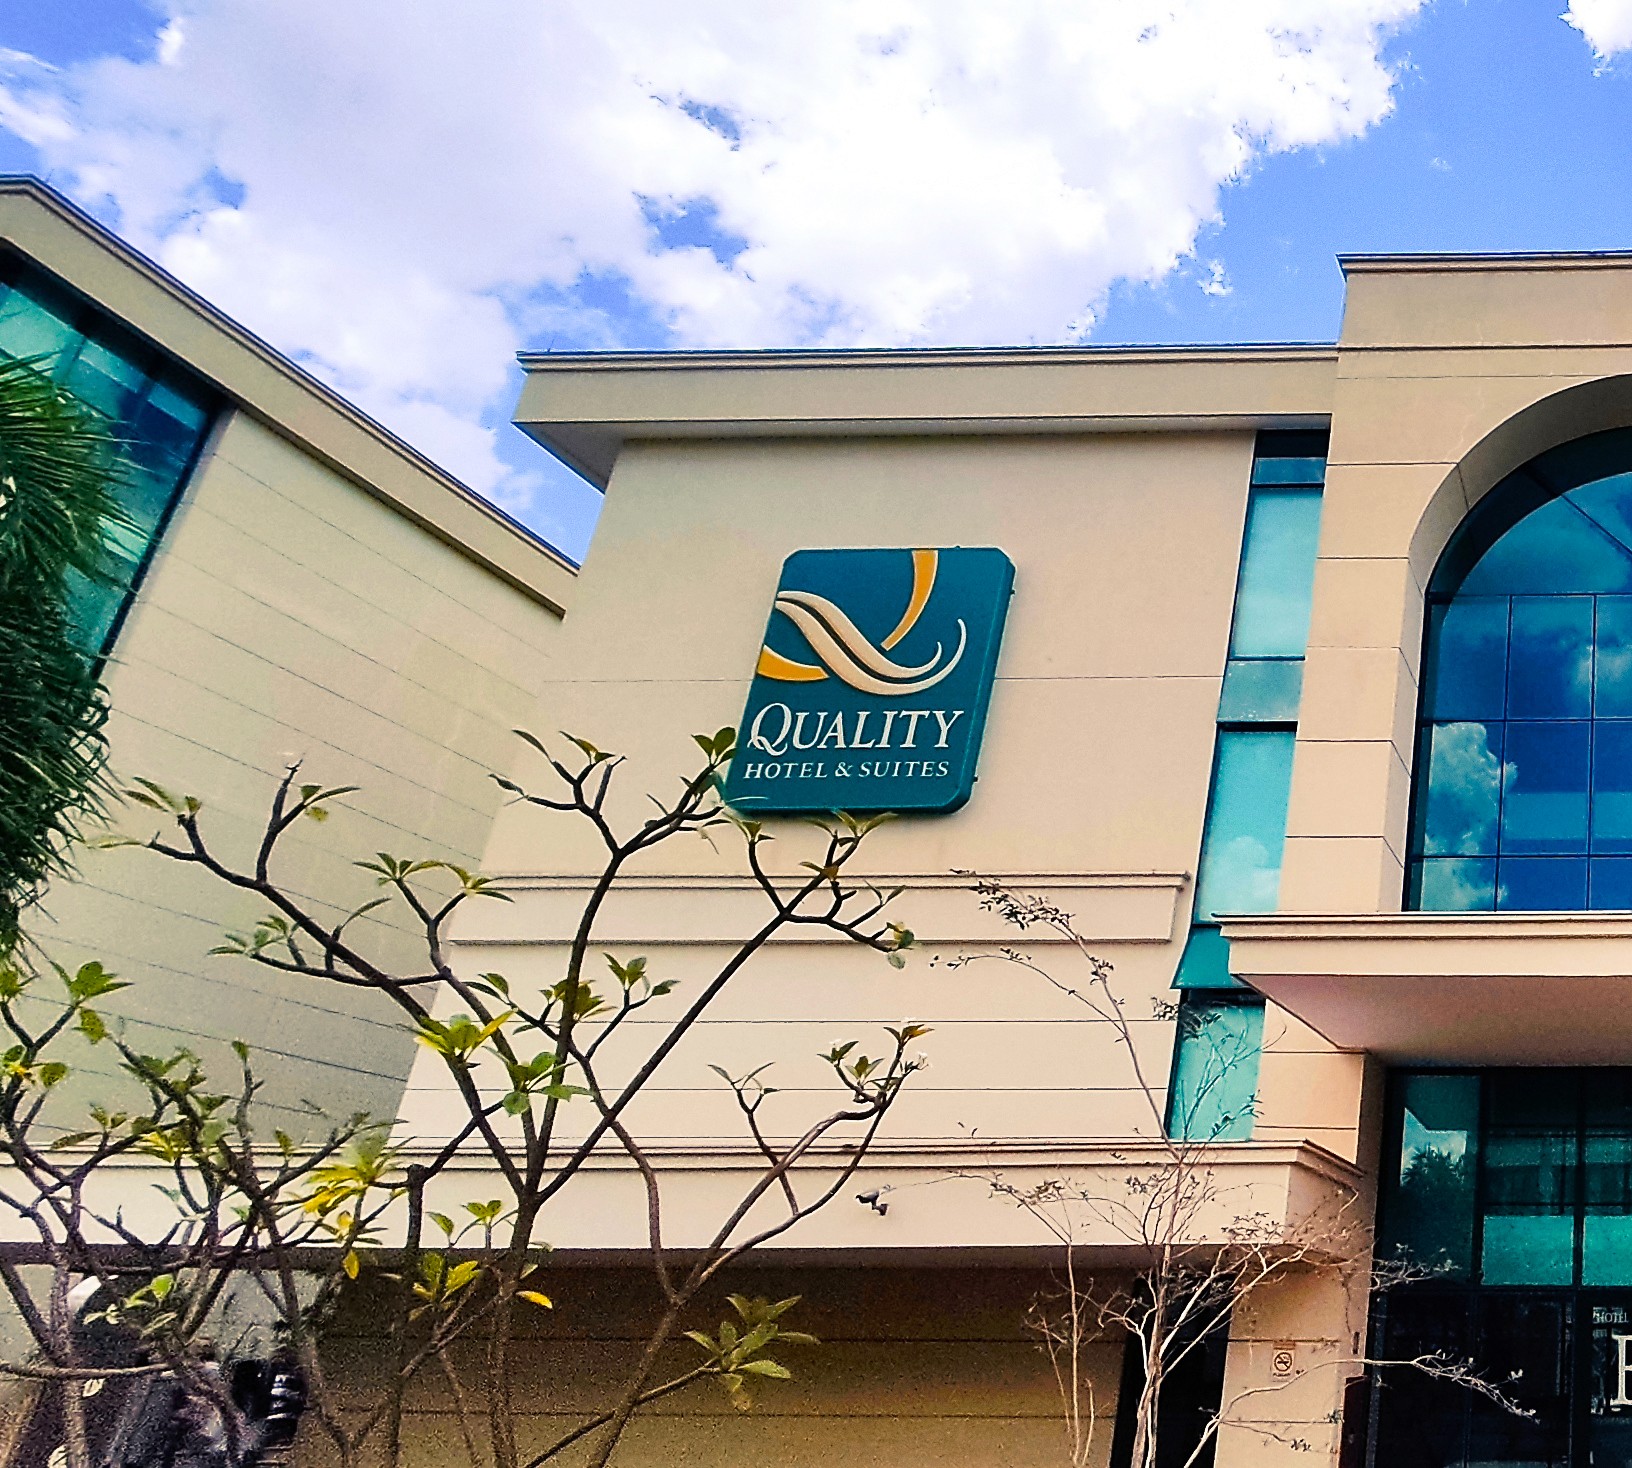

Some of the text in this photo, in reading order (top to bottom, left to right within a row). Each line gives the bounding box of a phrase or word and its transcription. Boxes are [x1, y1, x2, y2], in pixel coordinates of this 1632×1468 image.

[747, 702, 964, 756] QUALITY
[743, 761, 949, 779] HOTEL & SUITES
[1597, 1311, 1629, 1323] HOTEL
